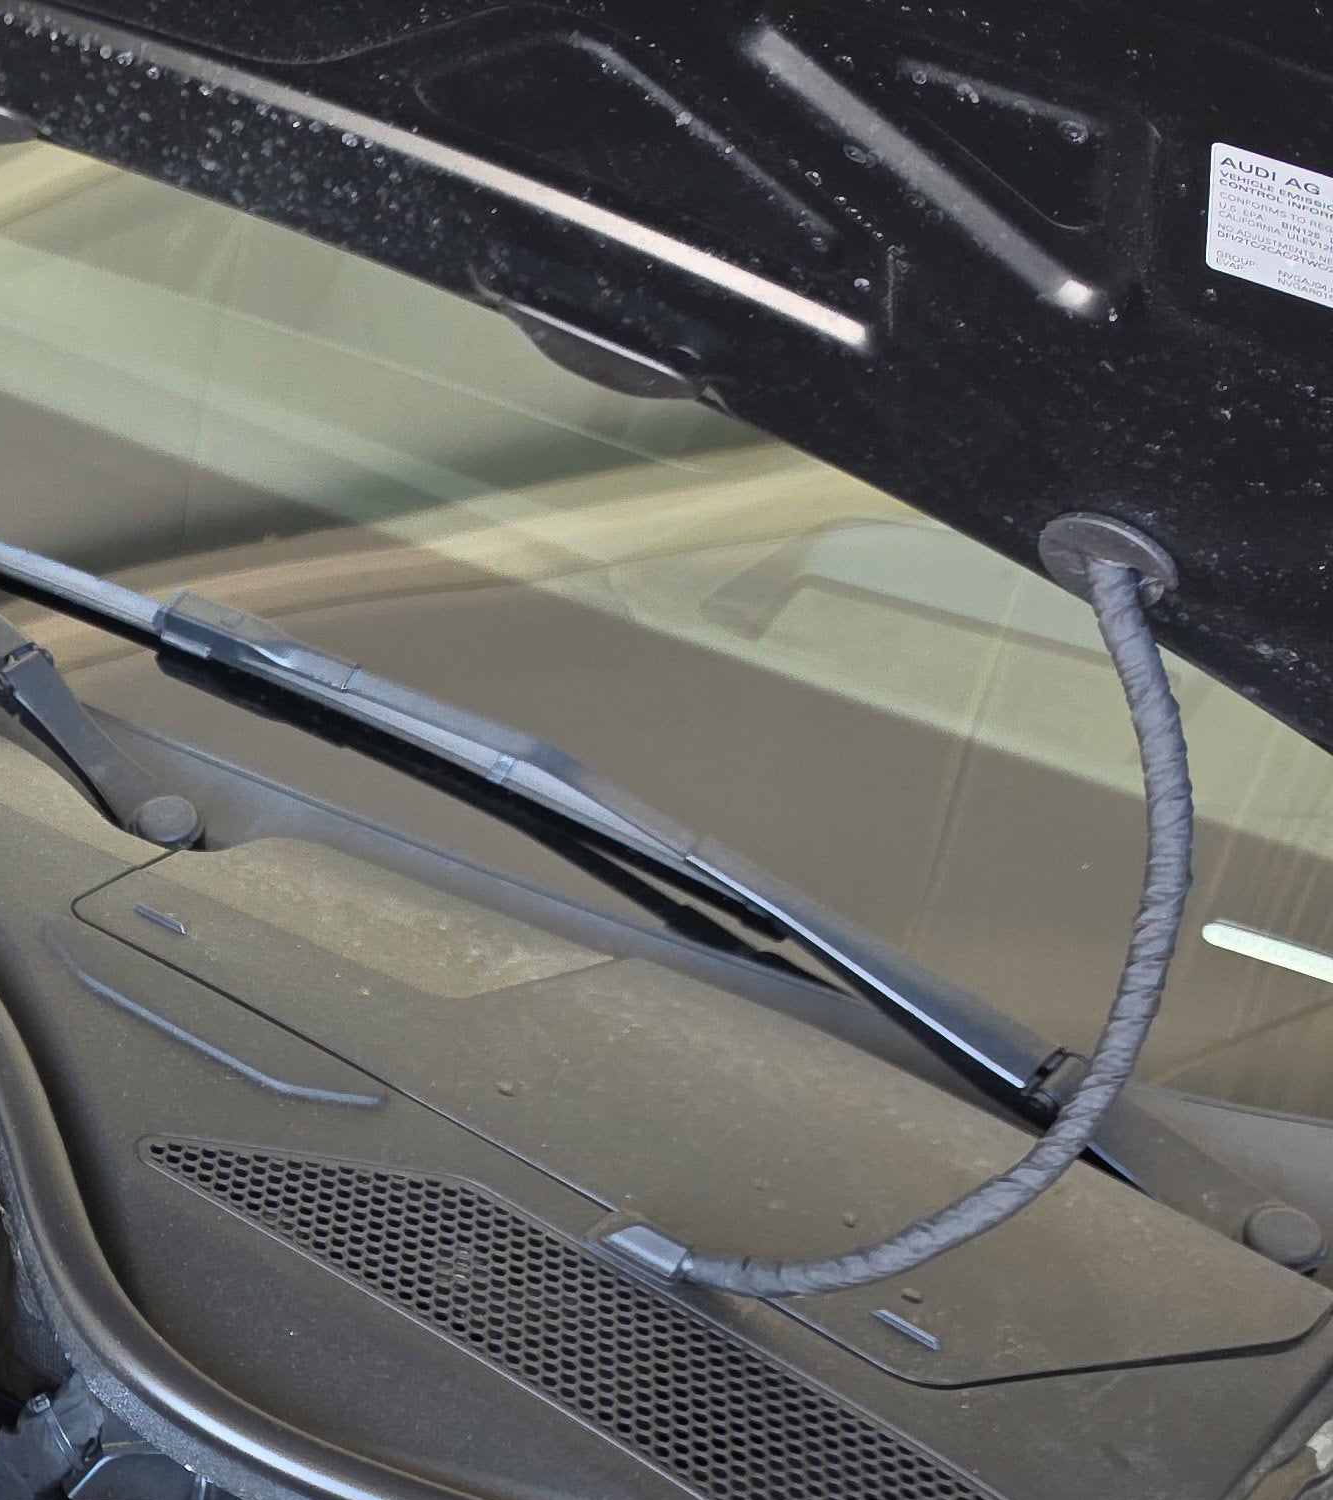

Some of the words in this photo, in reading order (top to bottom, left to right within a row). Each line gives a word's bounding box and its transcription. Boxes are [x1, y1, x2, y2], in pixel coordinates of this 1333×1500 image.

[1219, 178, 1283, 204] CONTROL
[1220, 157, 1276, 182] AUDI
[1285, 177, 1320, 195] AG
[1220, 170, 1275, 193] VEHICLE
[1220, 191, 1287, 219] CONFORMS
[1290, 213, 1306, 224] TO
[1218, 222, 1233, 232] NO
[1236, 228, 1316, 260] ADJUSTMENTS
